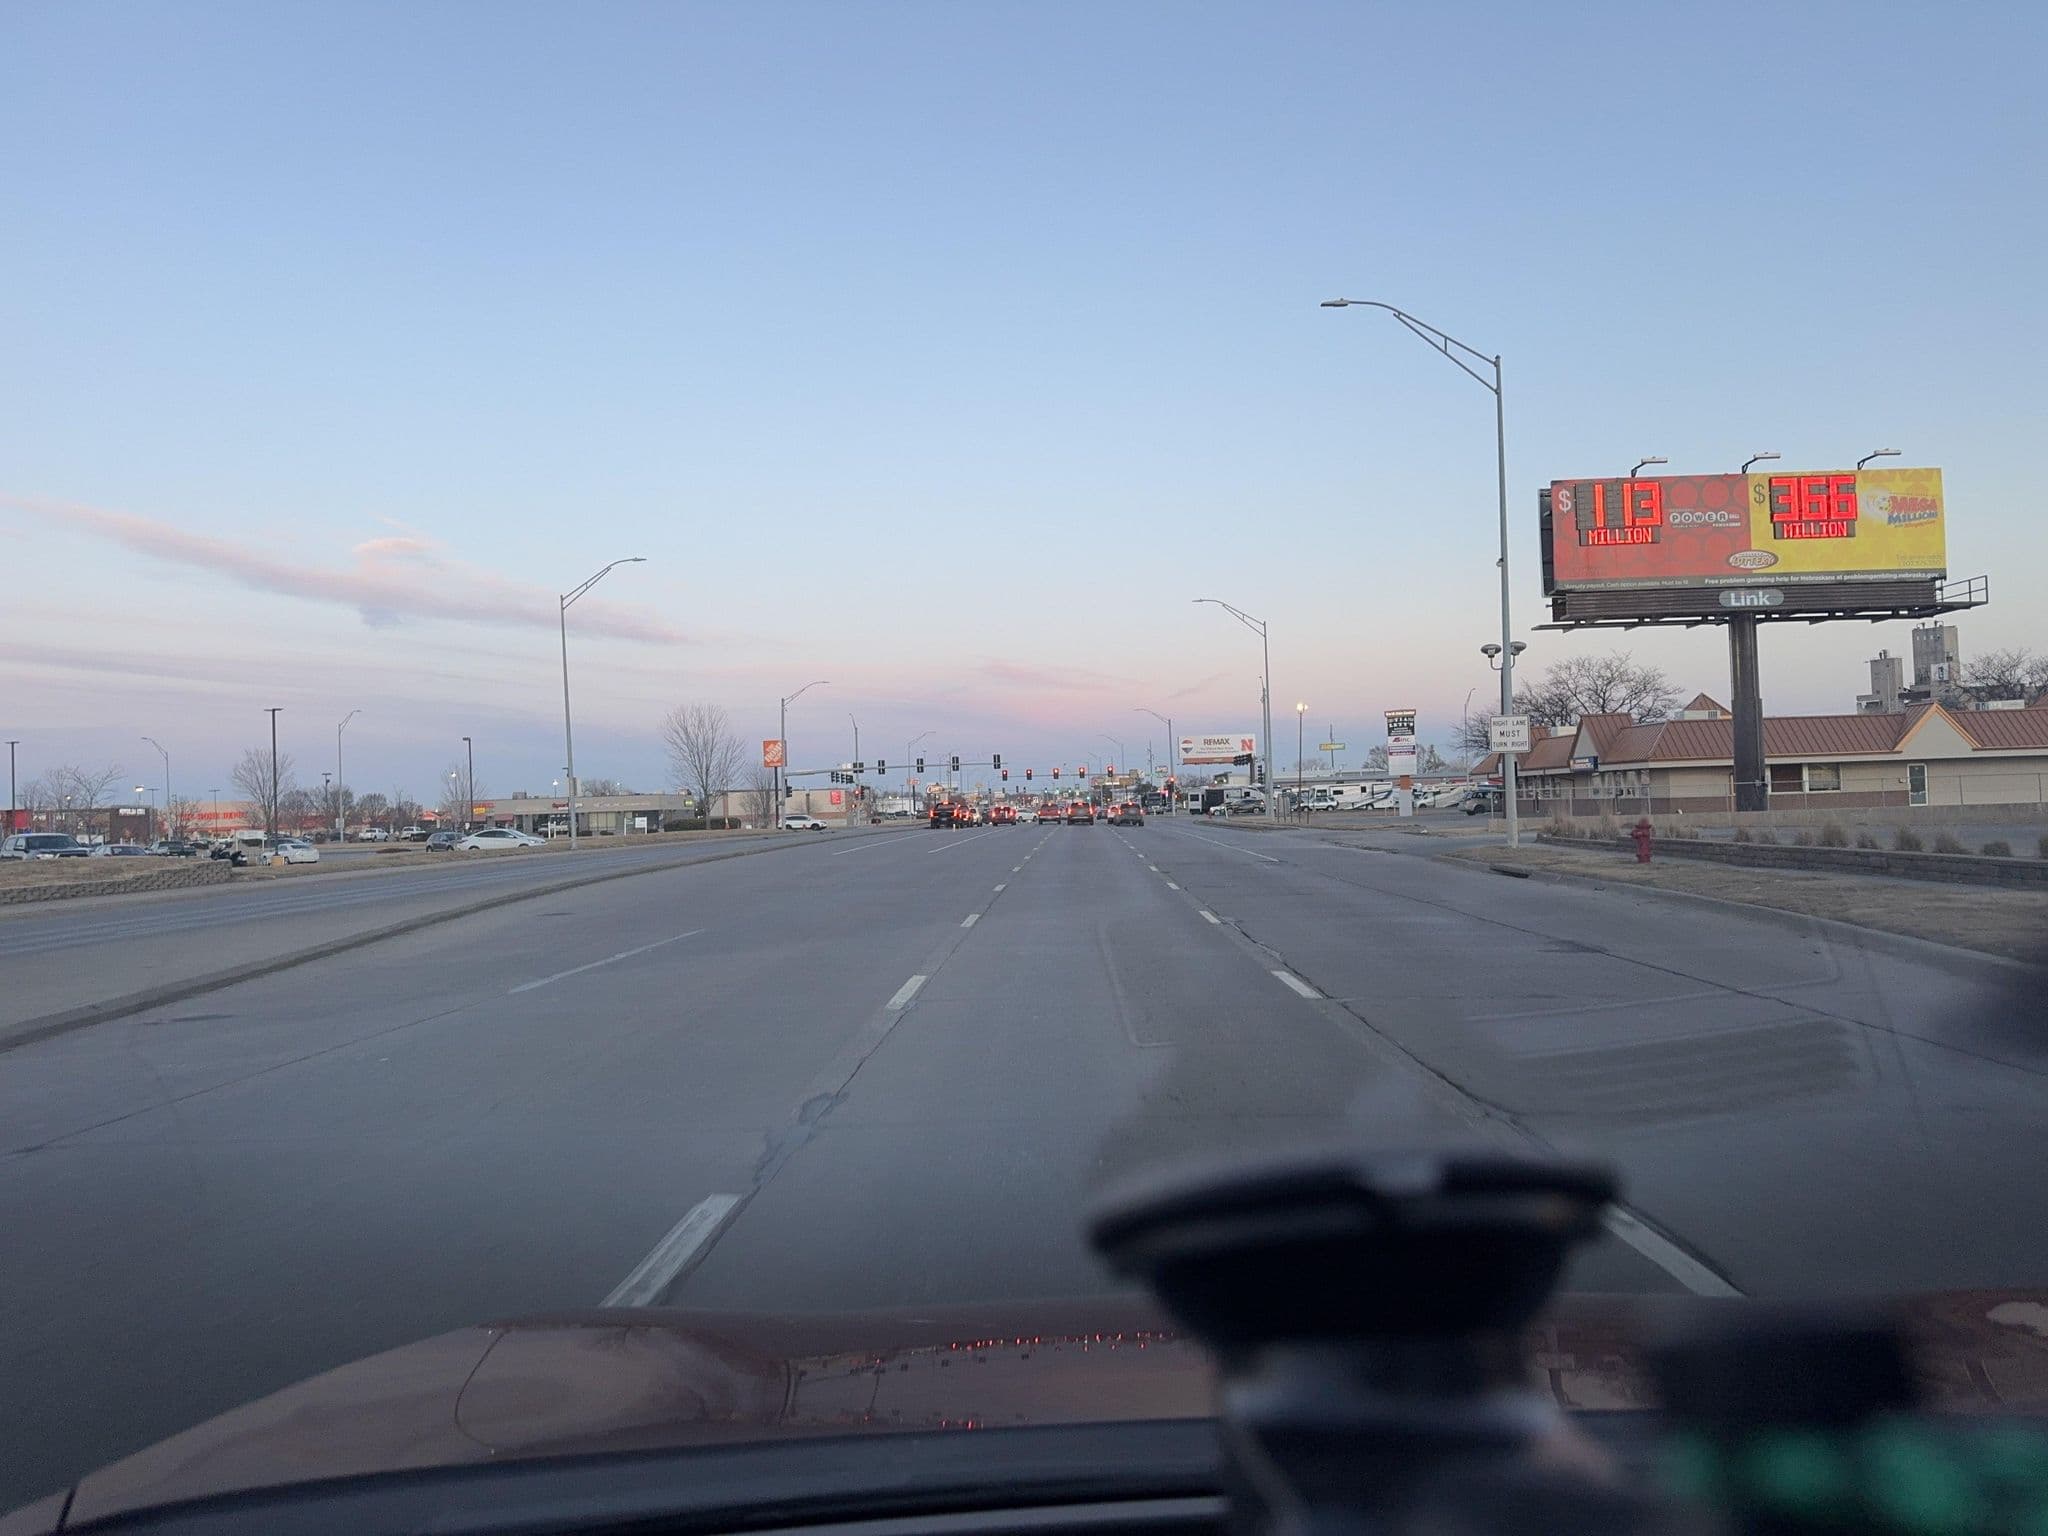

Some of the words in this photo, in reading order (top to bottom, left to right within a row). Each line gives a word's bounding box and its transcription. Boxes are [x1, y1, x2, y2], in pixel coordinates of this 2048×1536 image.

[1558, 489, 1572, 513] $
[1594, 482, 1661, 527] 113
[1753, 483, 1765, 506] $
[1771, 475, 1857, 520] 366
[1669, 511, 1728, 523] POWER
[1588, 528, 1652, 545] MILLION
[1784, 521, 1848, 538] MILLION
[1730, 592, 1771, 606] Link
[1511, 740, 1528, 748] RIGHT
